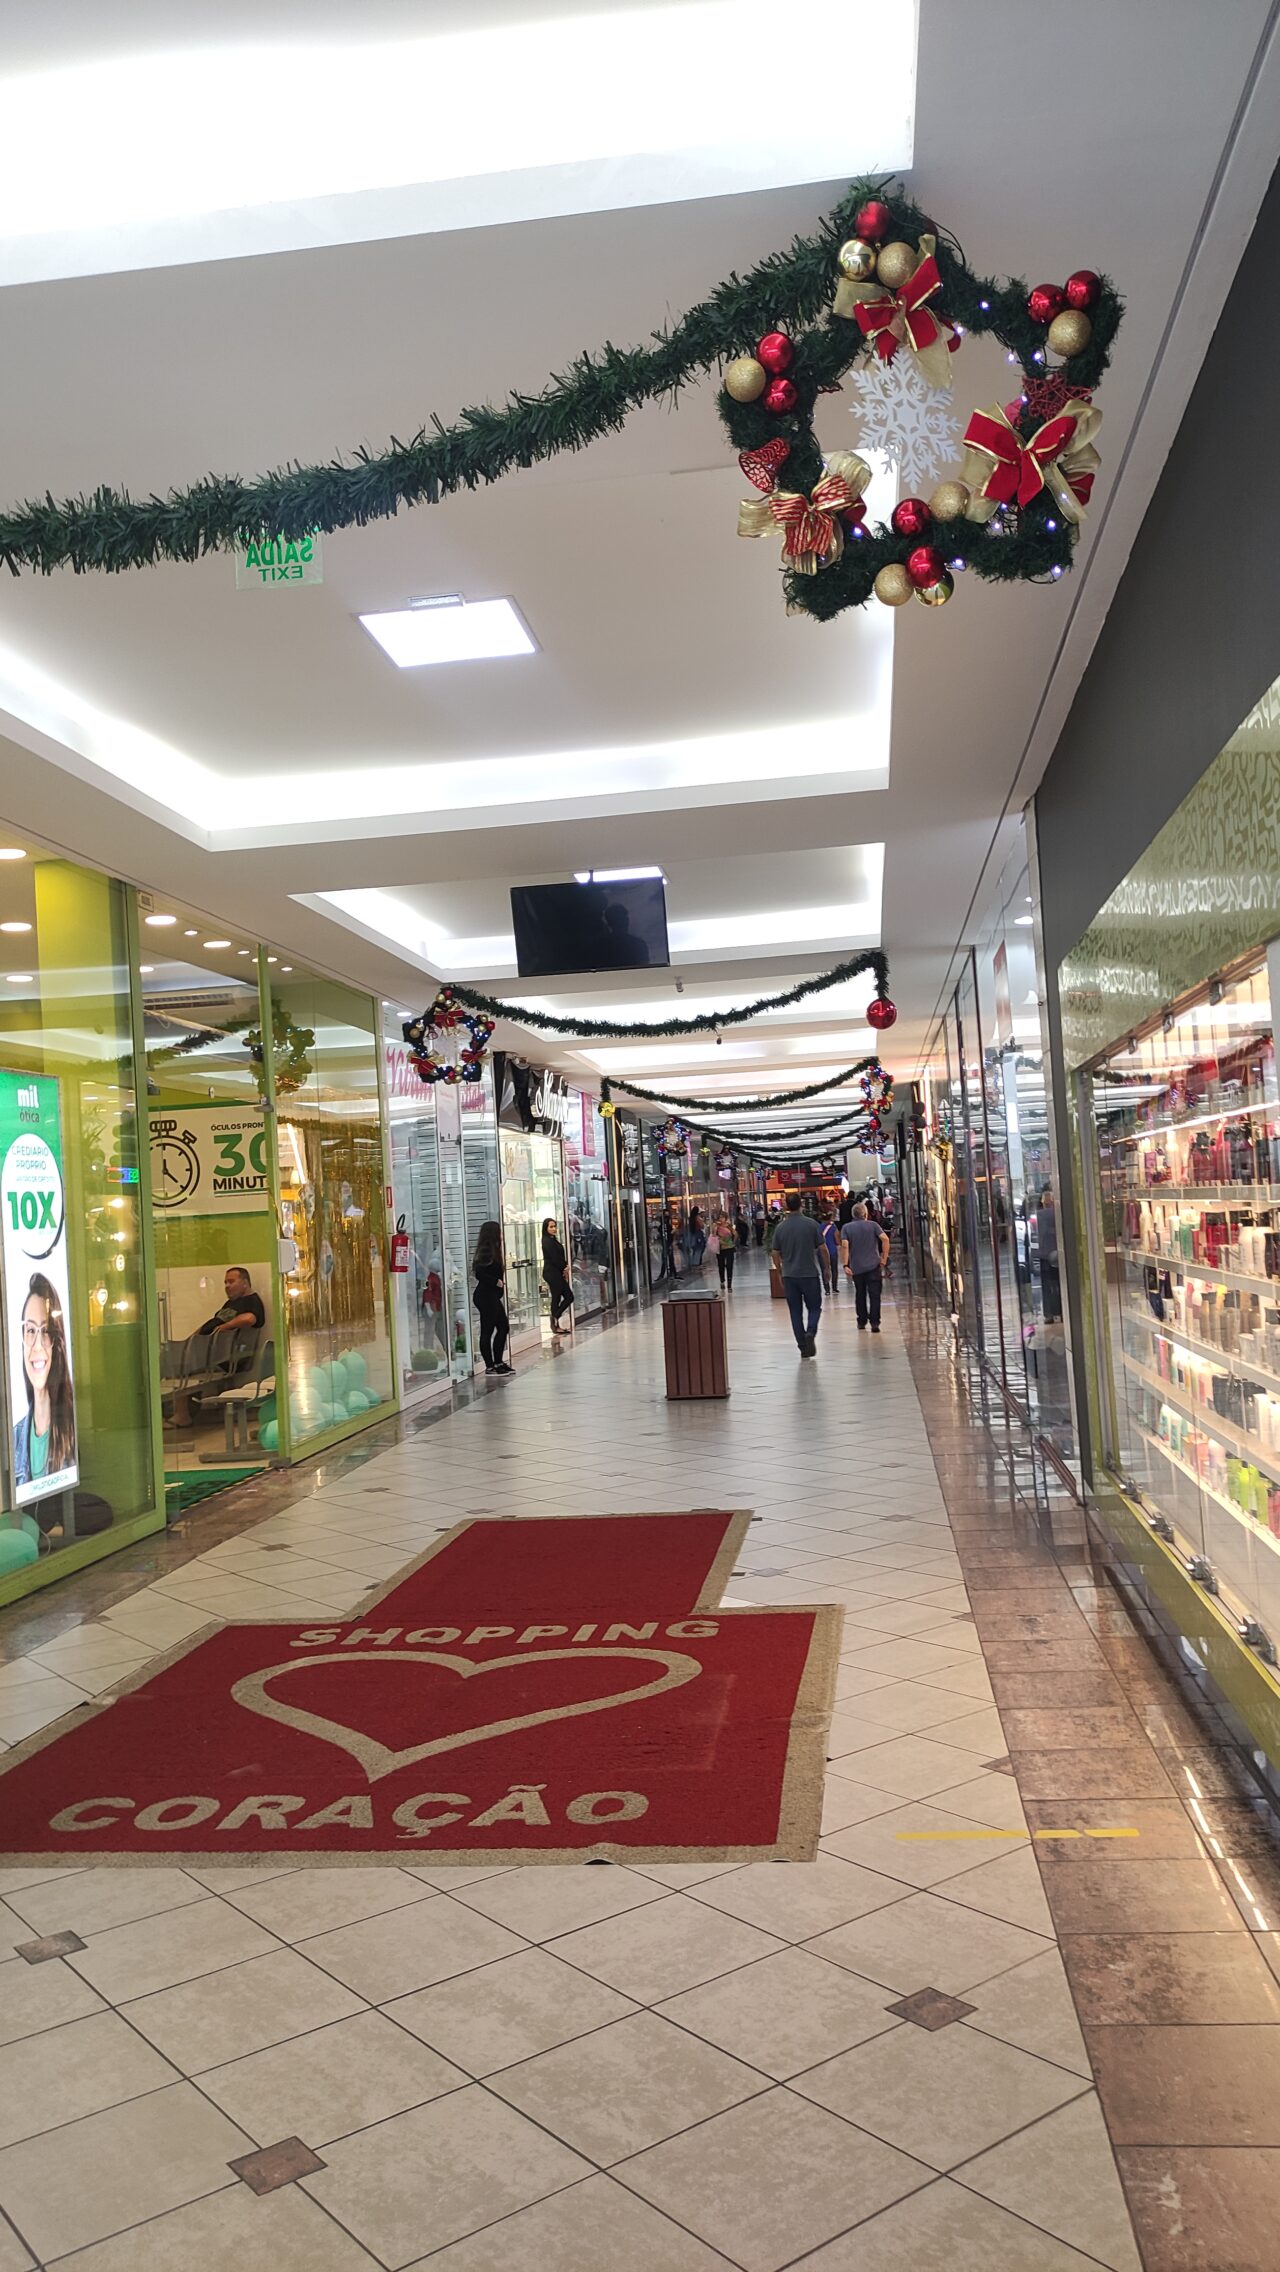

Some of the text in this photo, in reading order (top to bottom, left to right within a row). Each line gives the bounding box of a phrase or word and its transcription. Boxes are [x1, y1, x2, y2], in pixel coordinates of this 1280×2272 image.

[17, 1084, 40, 1109] mil
[19, 1108, 40, 1123] ótica
[210, 1122, 241, 1132] ÓCULOS
[7, 1191, 57, 1230] 10X
[289, 1620, 721, 1647] SHOPPING
[48, 1783, 650, 1838] CORAÇÃO
